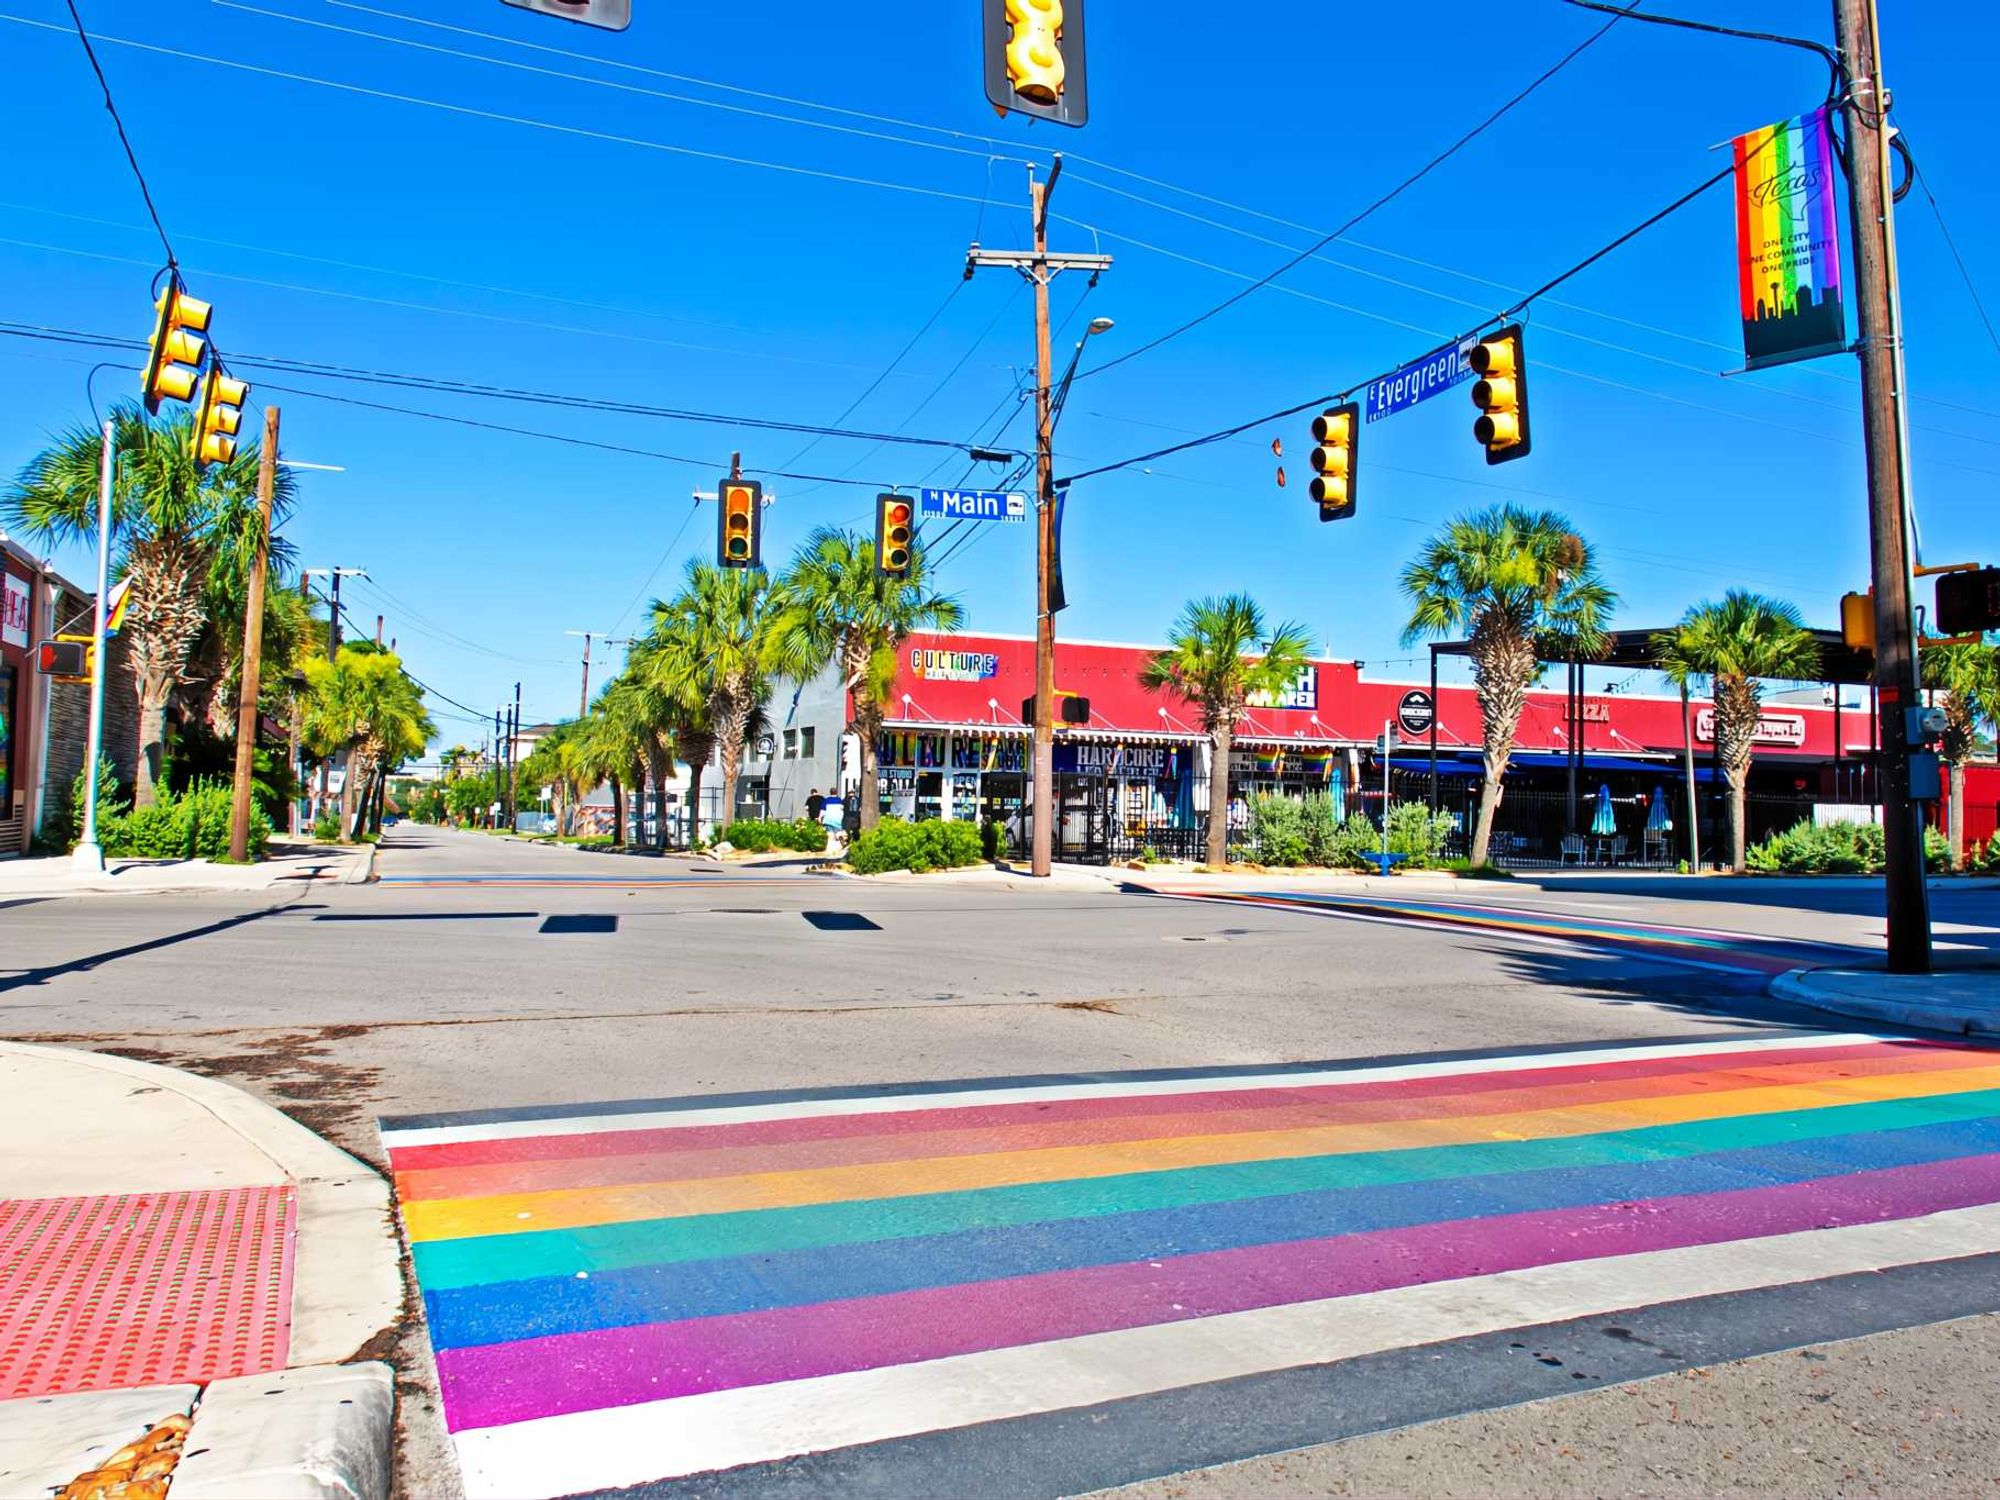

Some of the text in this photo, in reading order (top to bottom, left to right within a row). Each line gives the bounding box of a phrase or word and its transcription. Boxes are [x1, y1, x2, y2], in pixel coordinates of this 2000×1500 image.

[1753, 161, 1820, 208] Texas
[1763, 232, 1810, 250] ONE CITY
[1767, 238, 1834, 261] COMMUNITY
[1761, 255, 1815, 275] ONE PRIDE
[1370, 351, 1456, 411] E Evergreen
[930, 490, 999, 516] N Main
[911, 649, 994, 673] CULTURE
[1564, 703, 1610, 721] IZZA
